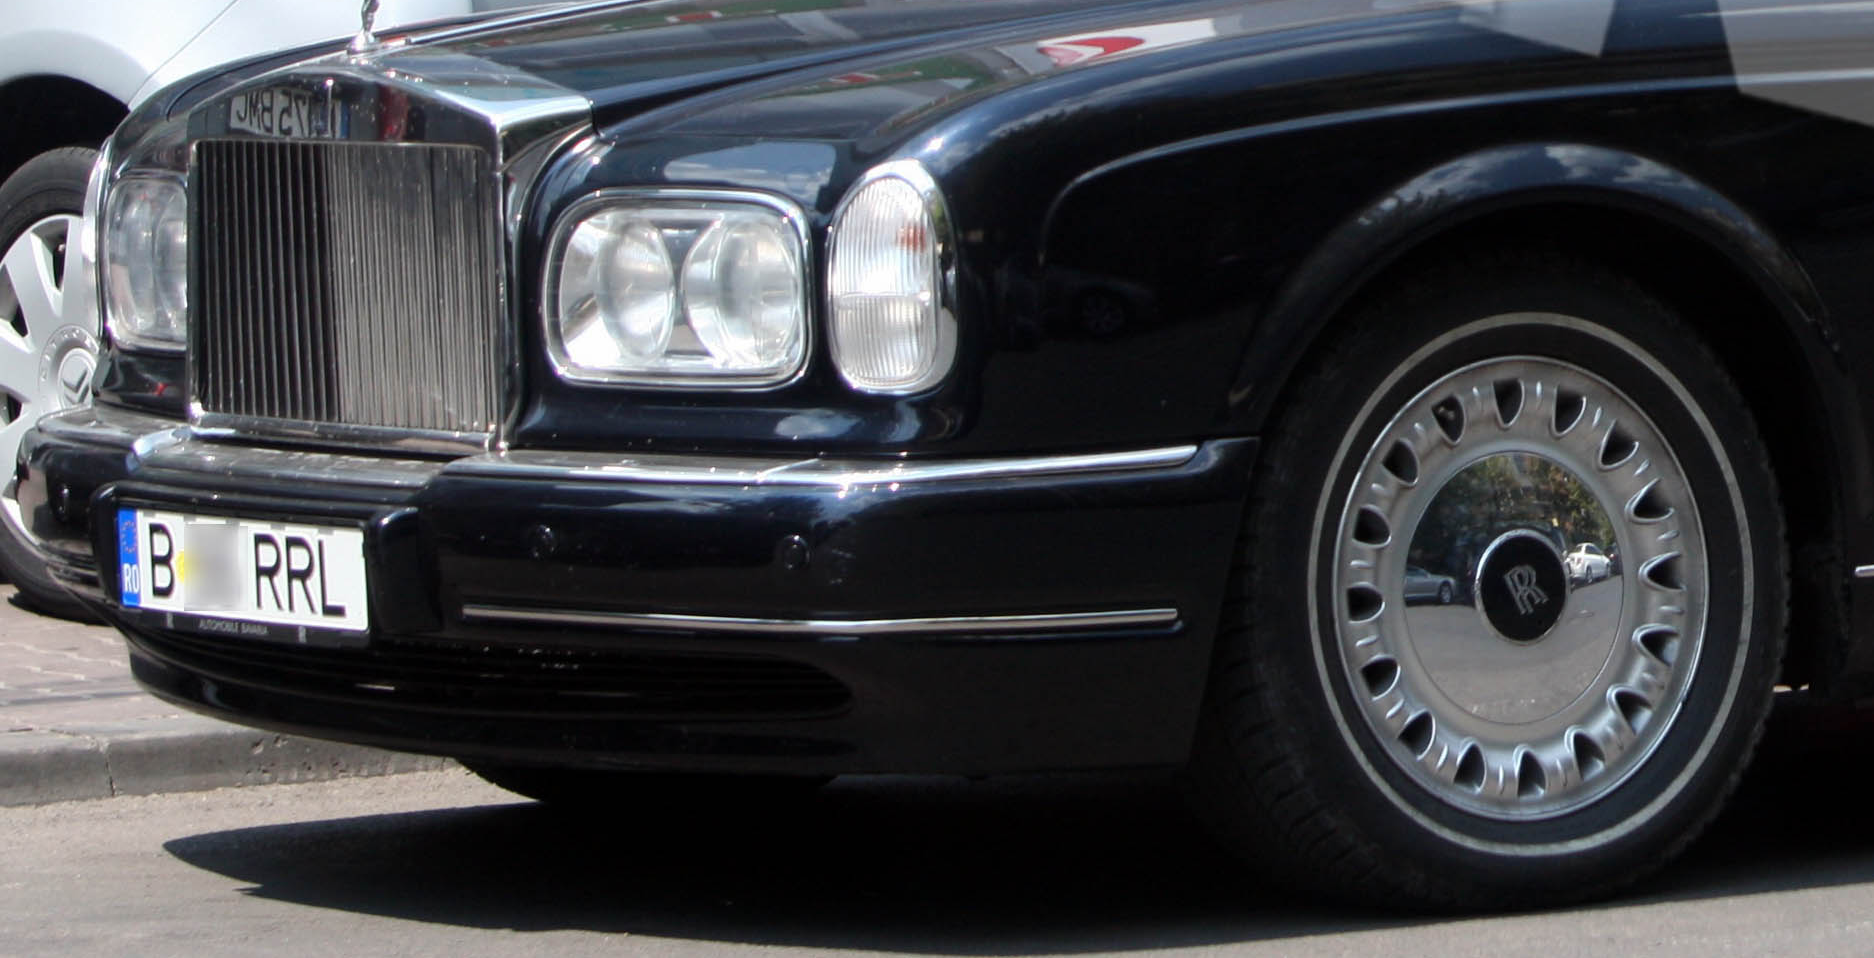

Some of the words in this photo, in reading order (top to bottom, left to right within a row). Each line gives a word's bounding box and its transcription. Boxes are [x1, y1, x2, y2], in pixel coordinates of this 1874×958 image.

[123, 563, 141, 593] RO
[148, 522, 175, 598] B
[253, 532, 347, 619] RRL
